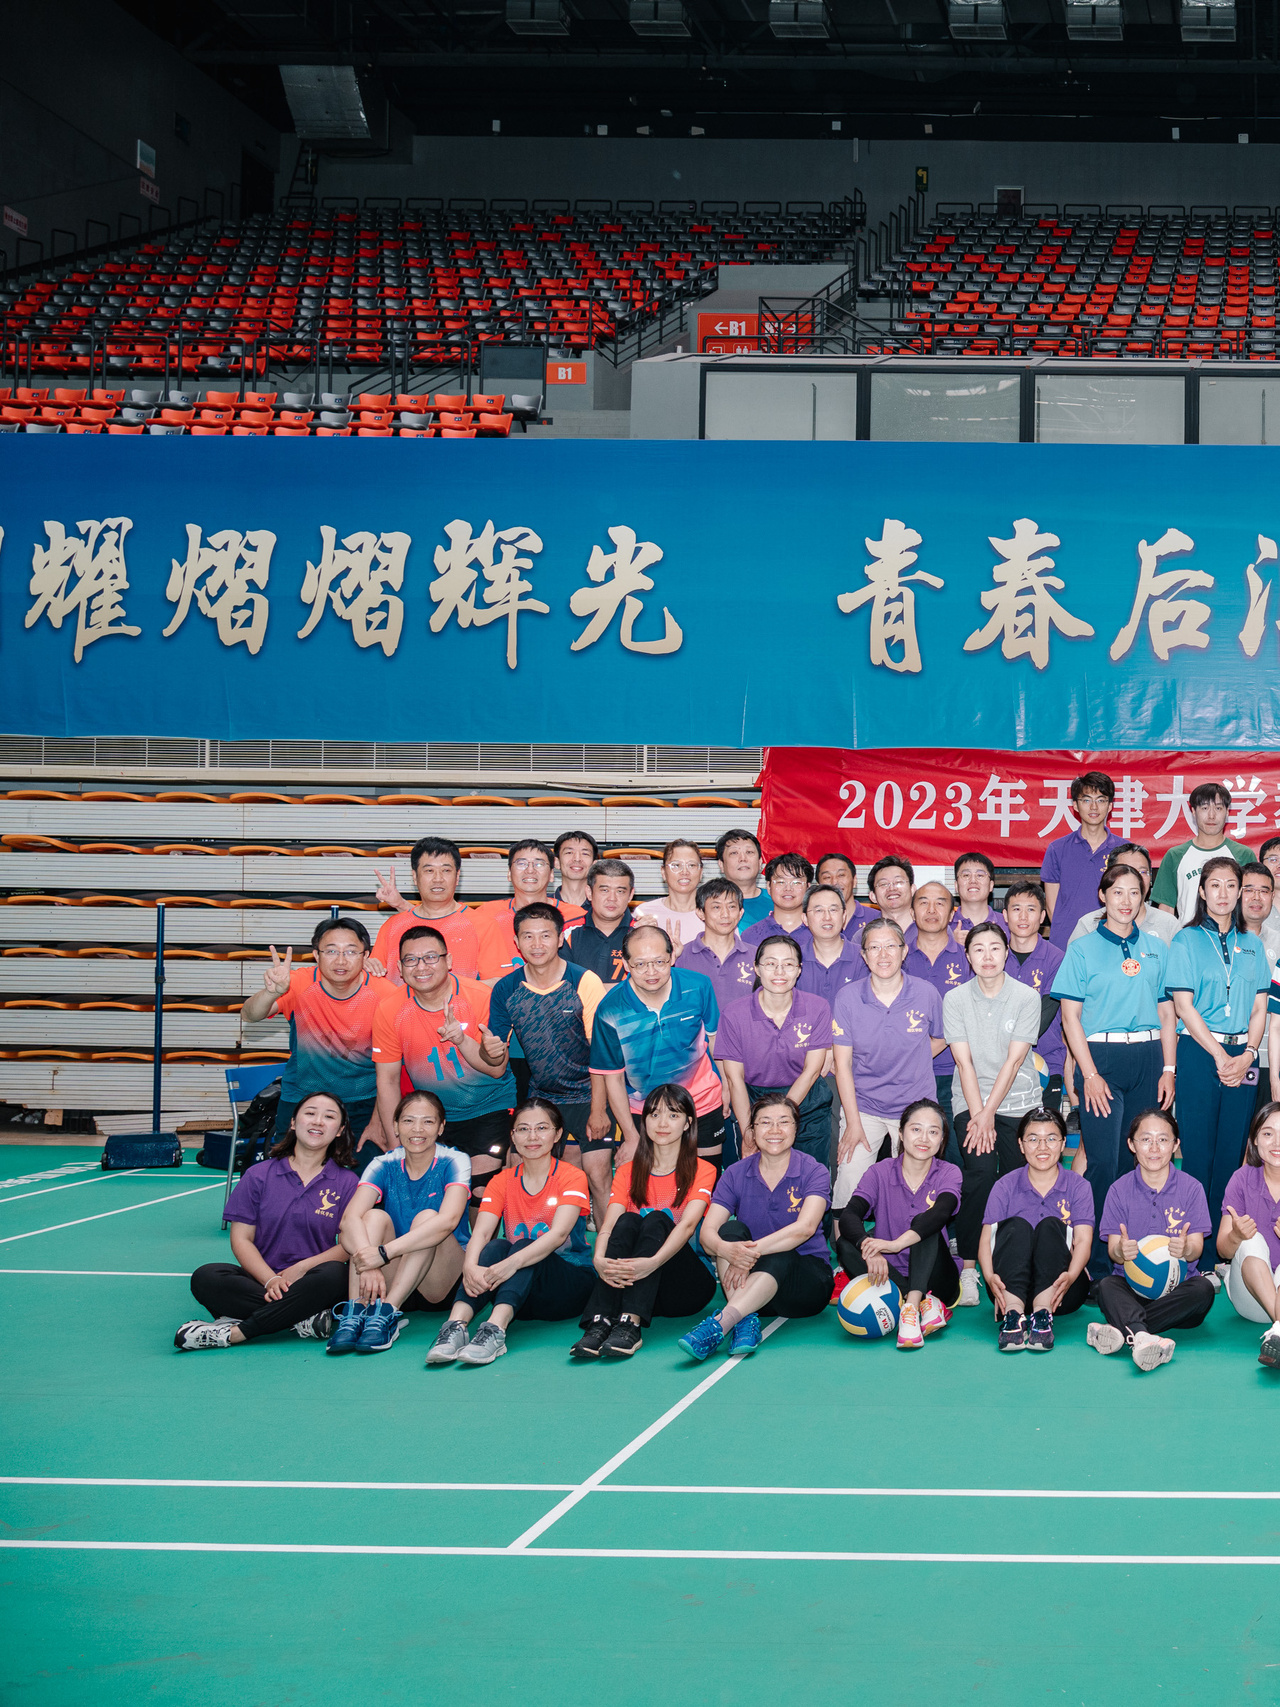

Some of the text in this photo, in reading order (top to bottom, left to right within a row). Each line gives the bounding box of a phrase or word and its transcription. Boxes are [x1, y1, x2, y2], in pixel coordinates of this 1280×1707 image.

[729, 321, 746, 336] B1
[558, 367, 572, 380] B1
[0, 517, 683, 670] 耀熠熠辉光
[427, 1046, 465, 1082] 11
